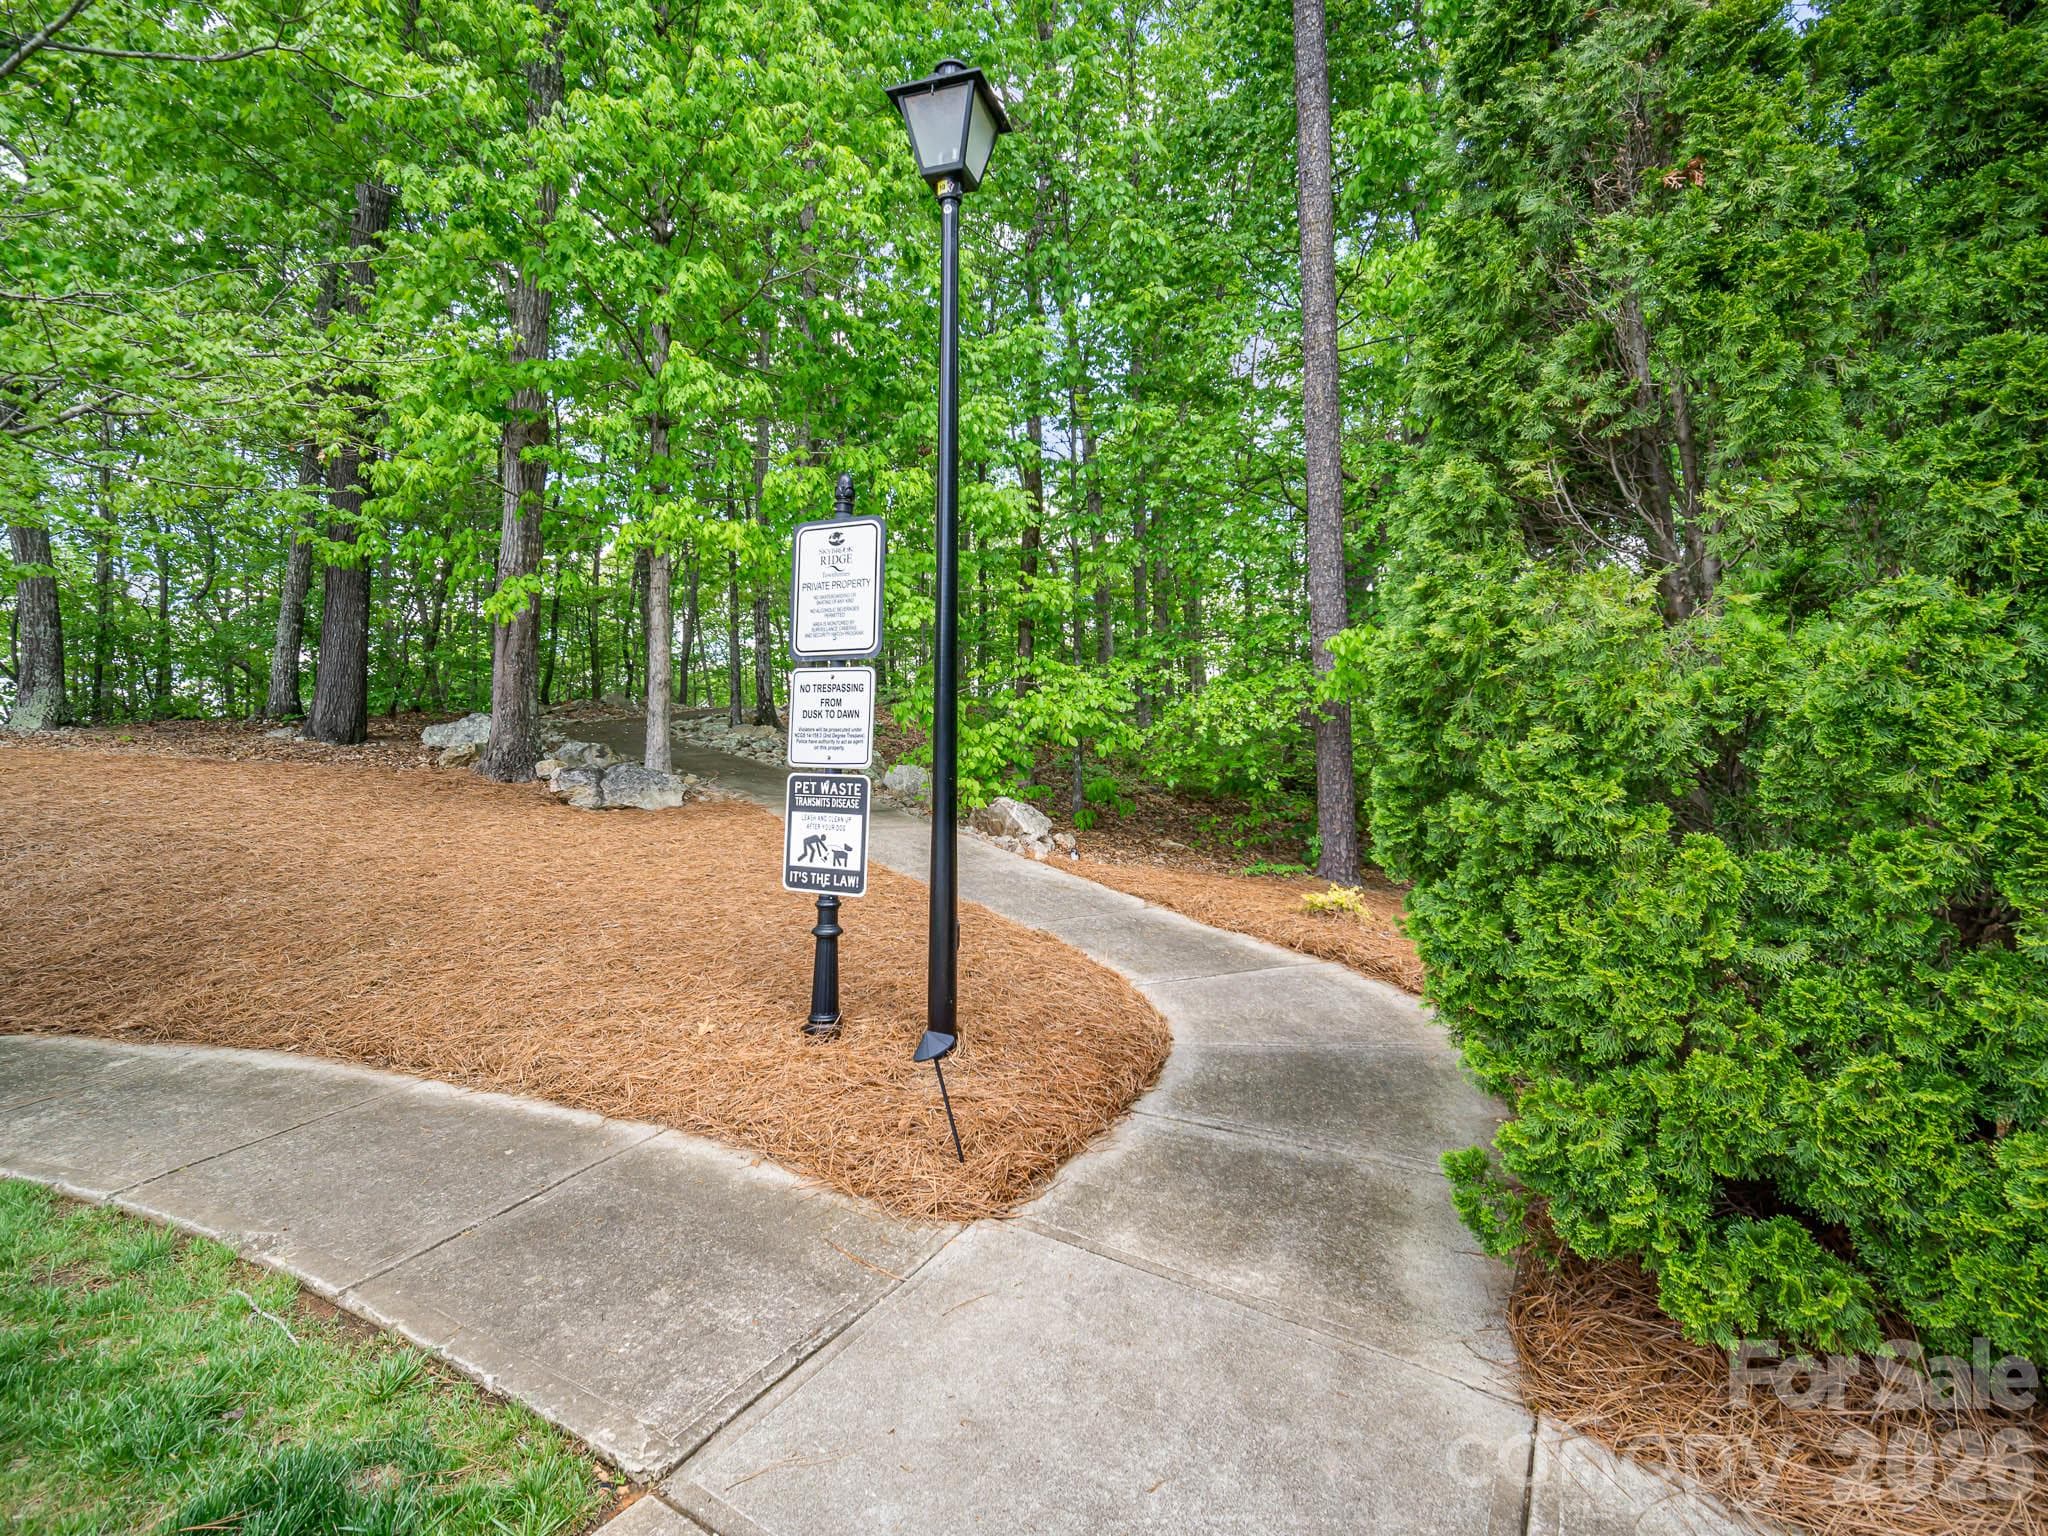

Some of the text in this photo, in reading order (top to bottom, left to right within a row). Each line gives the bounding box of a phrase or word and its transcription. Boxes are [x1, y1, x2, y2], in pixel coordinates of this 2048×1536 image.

[820, 554, 852, 566] RIDGE
[802, 578, 870, 591] PRIVATE PROPERTY
[800, 684, 864, 693] NO TRESPASSING
[820, 698, 842, 707] FROM
[802, 710, 860, 718] DUSK TO DAWN
[794, 781, 861, 796] PET WASTE
[795, 797, 860, 809] TRANSMITS DISEASE
[789, 871, 859, 888] IT'S THE LAW!
